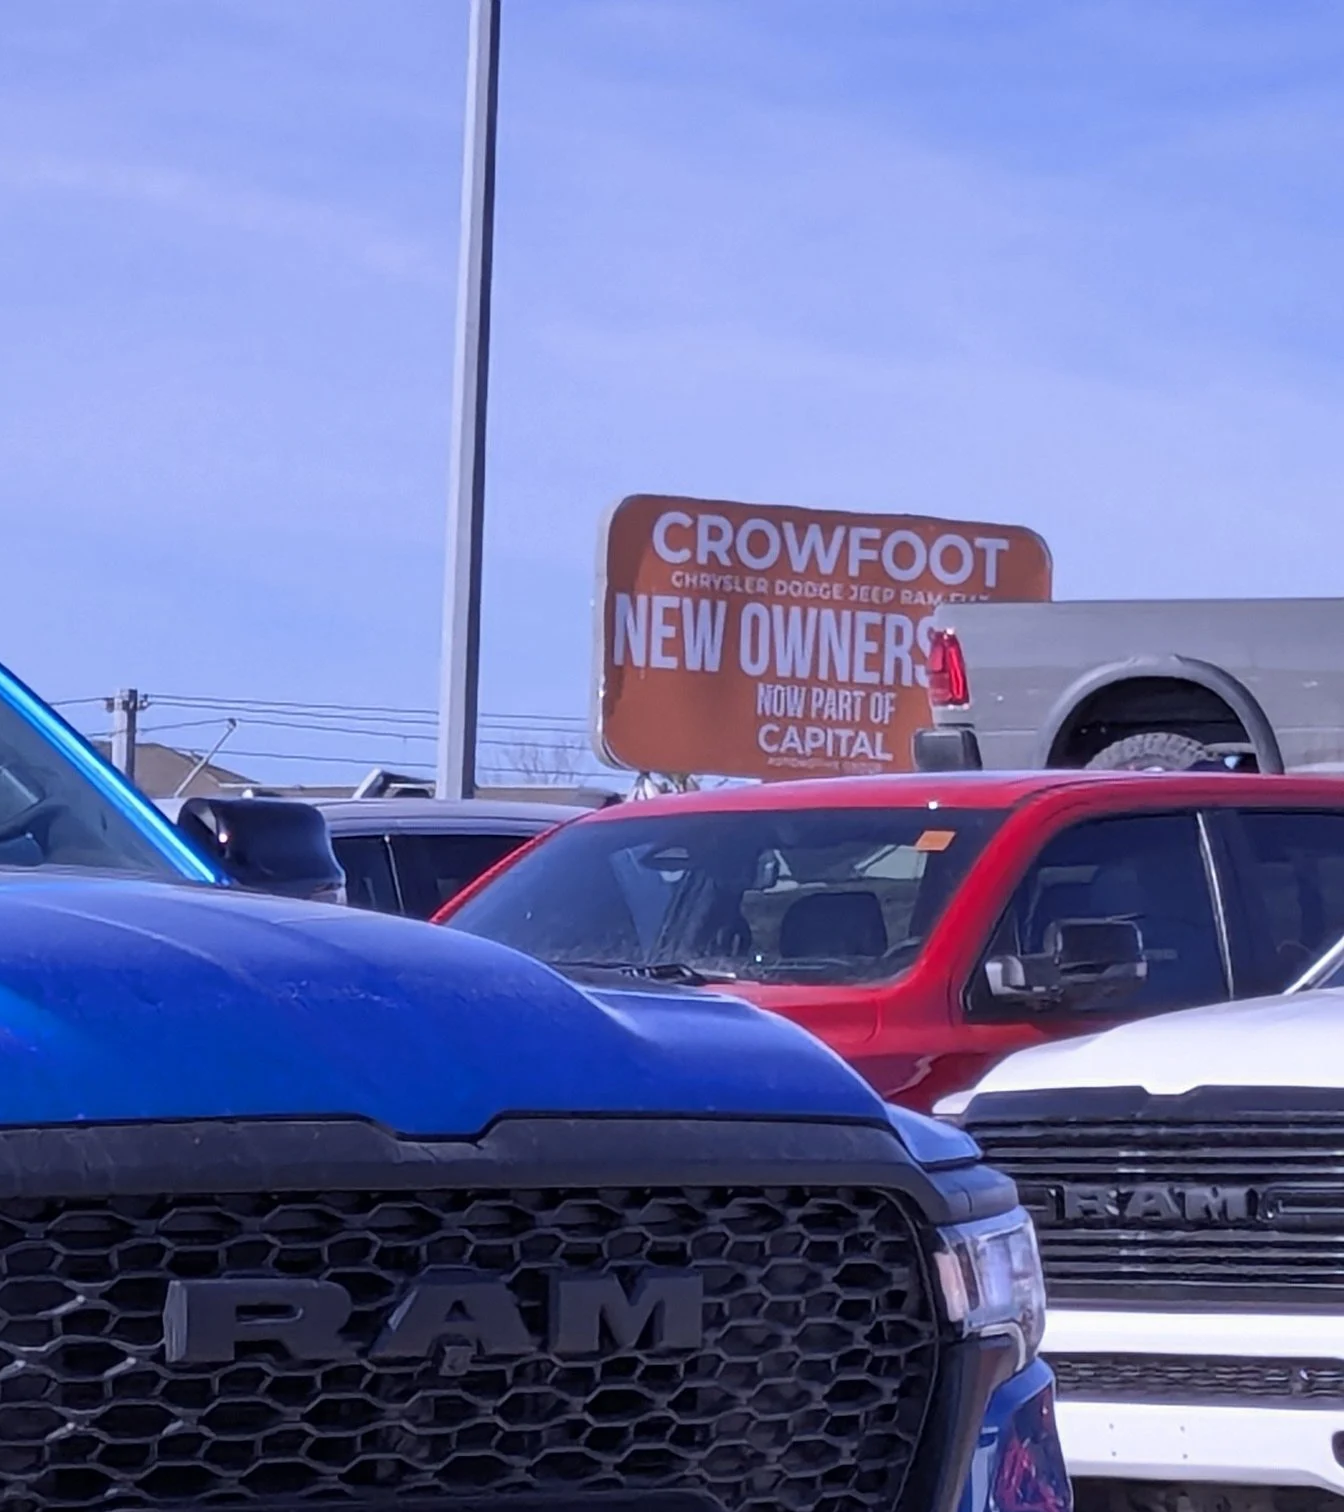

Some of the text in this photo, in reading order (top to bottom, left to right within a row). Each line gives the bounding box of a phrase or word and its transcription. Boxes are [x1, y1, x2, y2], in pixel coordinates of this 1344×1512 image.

[652, 511, 1010, 588] CROWFOOT
[671, 570, 769, 595] CHRYSLER
[774, 579, 843, 600] DODGE
[849, 584, 894, 604] JEEP
[613, 592, 728, 673] NEW
[756, 682, 897, 725] NOW PART OF
[758, 723, 894, 762] CAPITAL
[1064, 1183, 1258, 1220] RAM
[163, 1266, 704, 1363] RAM
